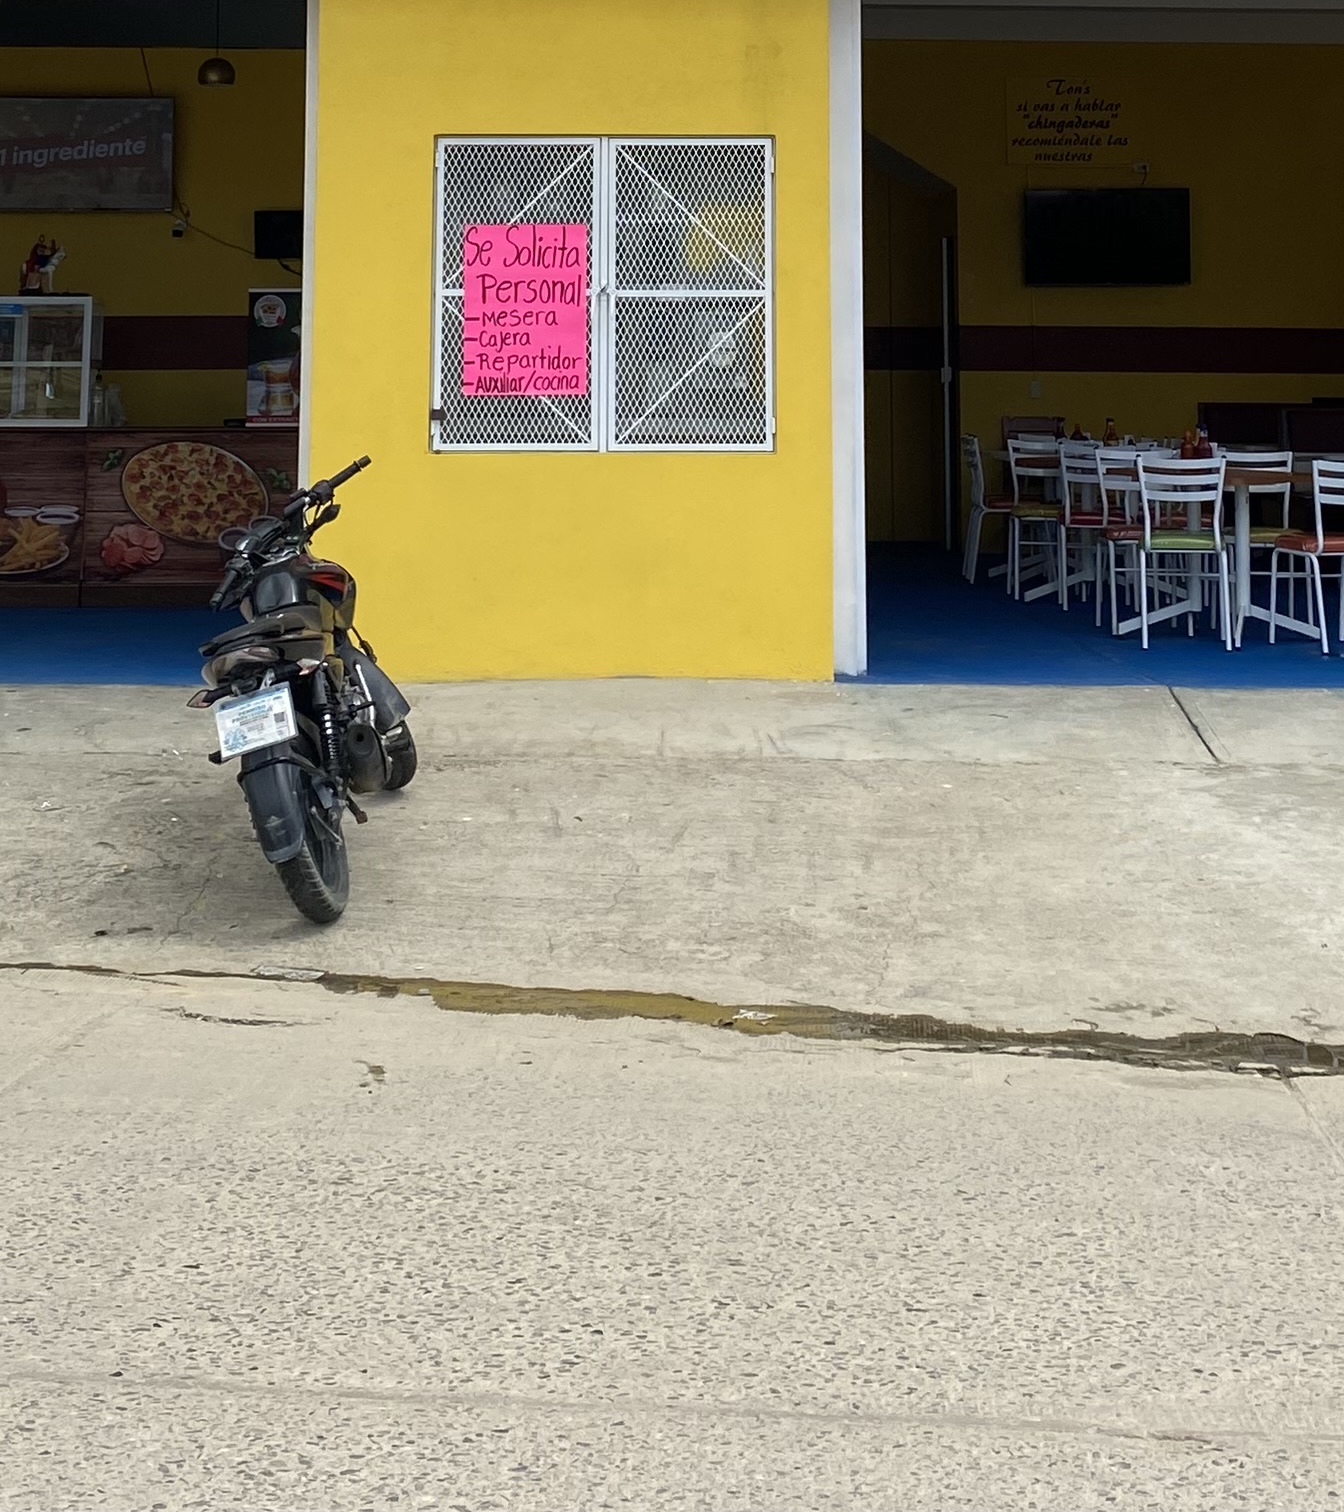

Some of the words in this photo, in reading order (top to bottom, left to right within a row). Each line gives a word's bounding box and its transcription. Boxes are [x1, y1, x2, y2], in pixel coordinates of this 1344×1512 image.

[1016, 101, 1027, 112] si
[1060, 103, 1069, 111] a
[1075, 98, 1121, 112] hablar
[1107, 134, 1128, 146] las
[12, 137, 147, 168] ingrediente
[1034, 151, 1093, 162] nuestras
[466, 226, 493, 267] Se
[503, 225, 581, 269] Solicita
[476, 273, 582, 307] Personal
